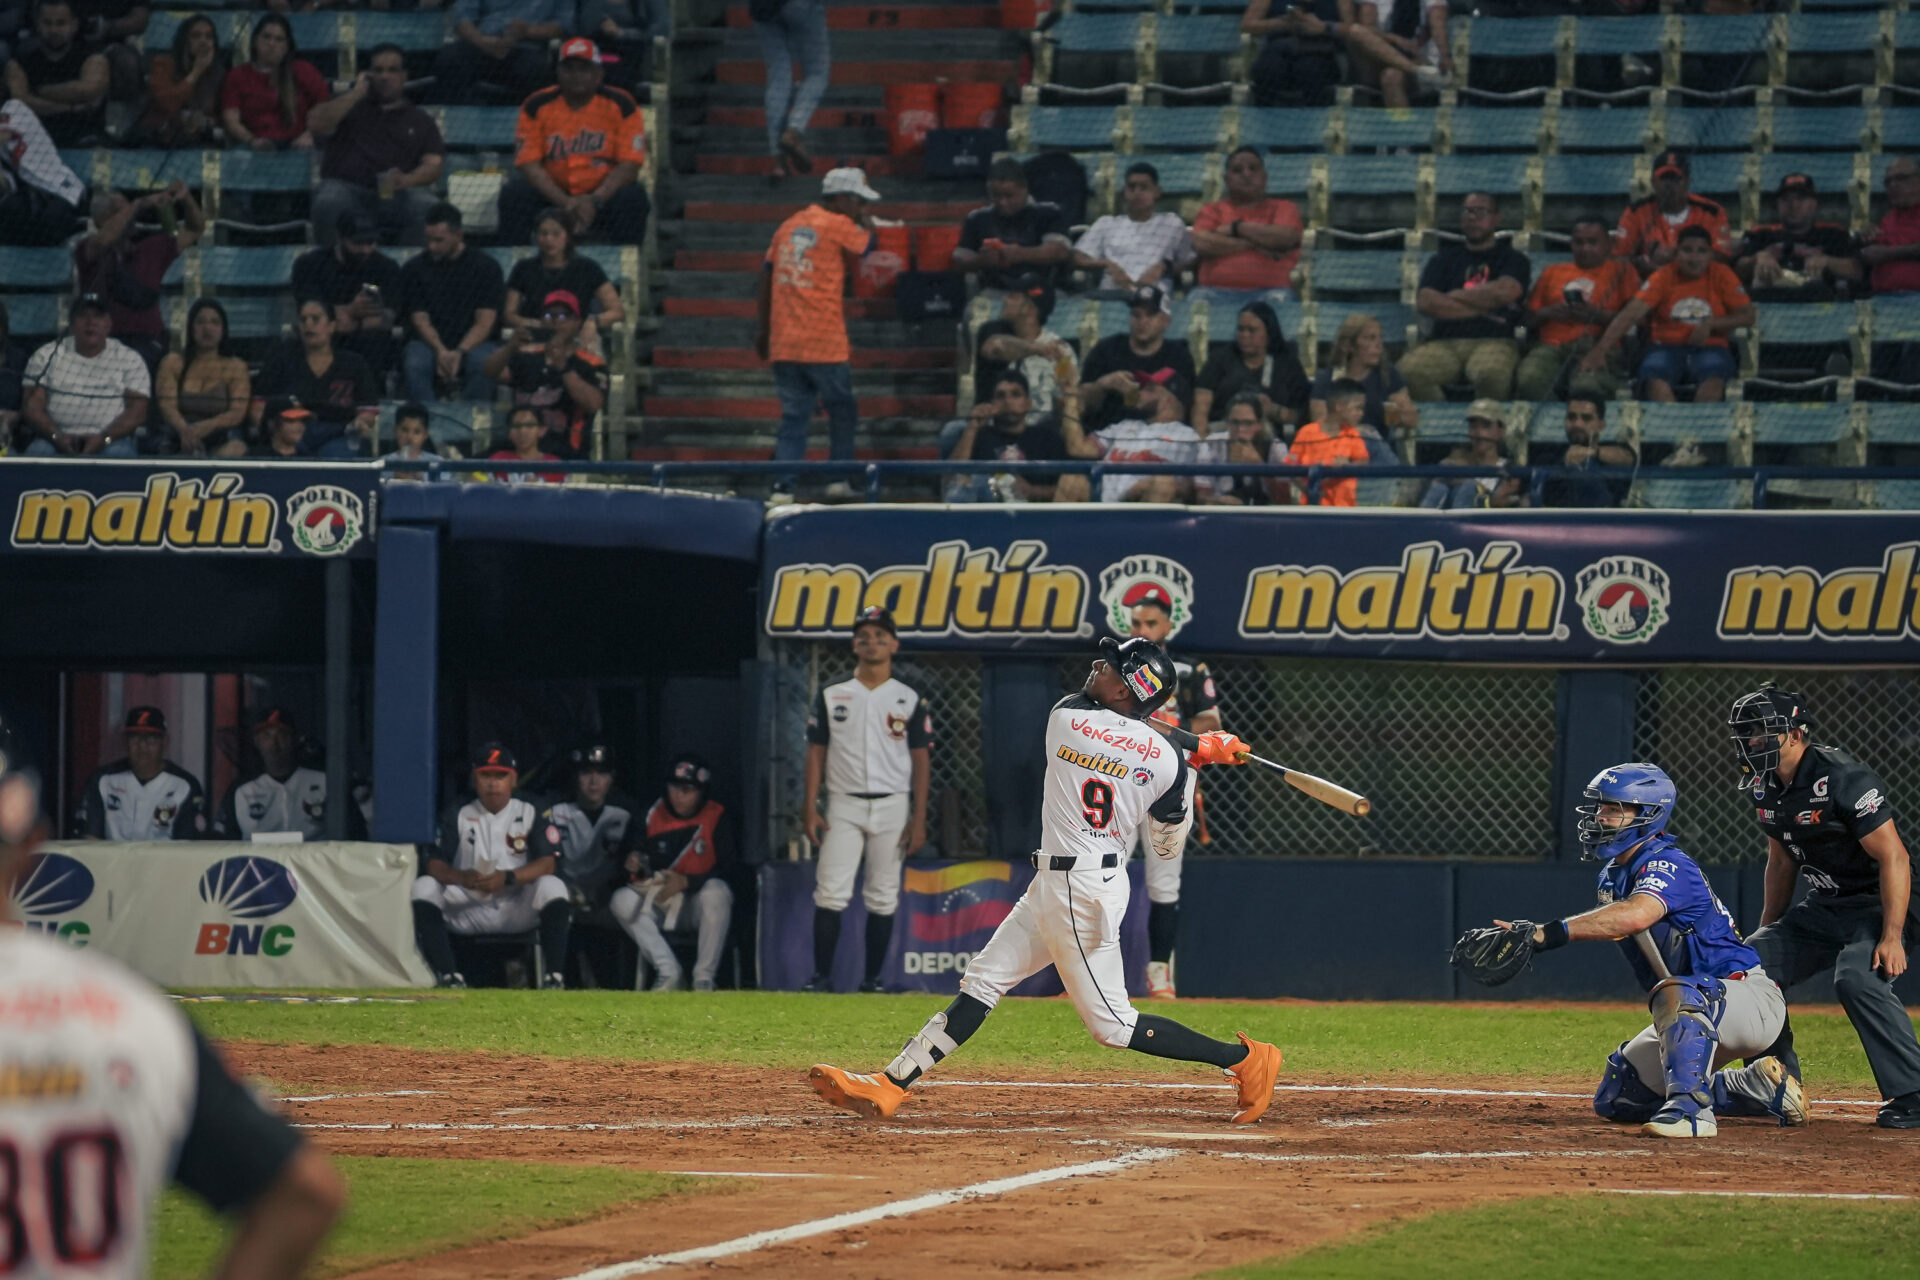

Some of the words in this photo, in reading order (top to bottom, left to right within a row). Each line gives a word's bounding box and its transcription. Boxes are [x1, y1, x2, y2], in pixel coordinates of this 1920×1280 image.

[11, 472, 277, 552] maltín
[290, 487, 361, 521] POLAR
[767, 540, 1090, 639] maltín
[1105, 557, 1190, 596] POLAR
[1239, 541, 1566, 640] maltín
[1579, 558, 1668, 597] POLAR
[1126, 672, 1148, 702] DEPORTE
[1056, 744, 1130, 780] maltín
[1081, 777, 1116, 830] 9
[1647, 859, 1679, 874] BDT
[195, 923, 296, 957] BNC
[904, 951, 980, 974] DEPO
